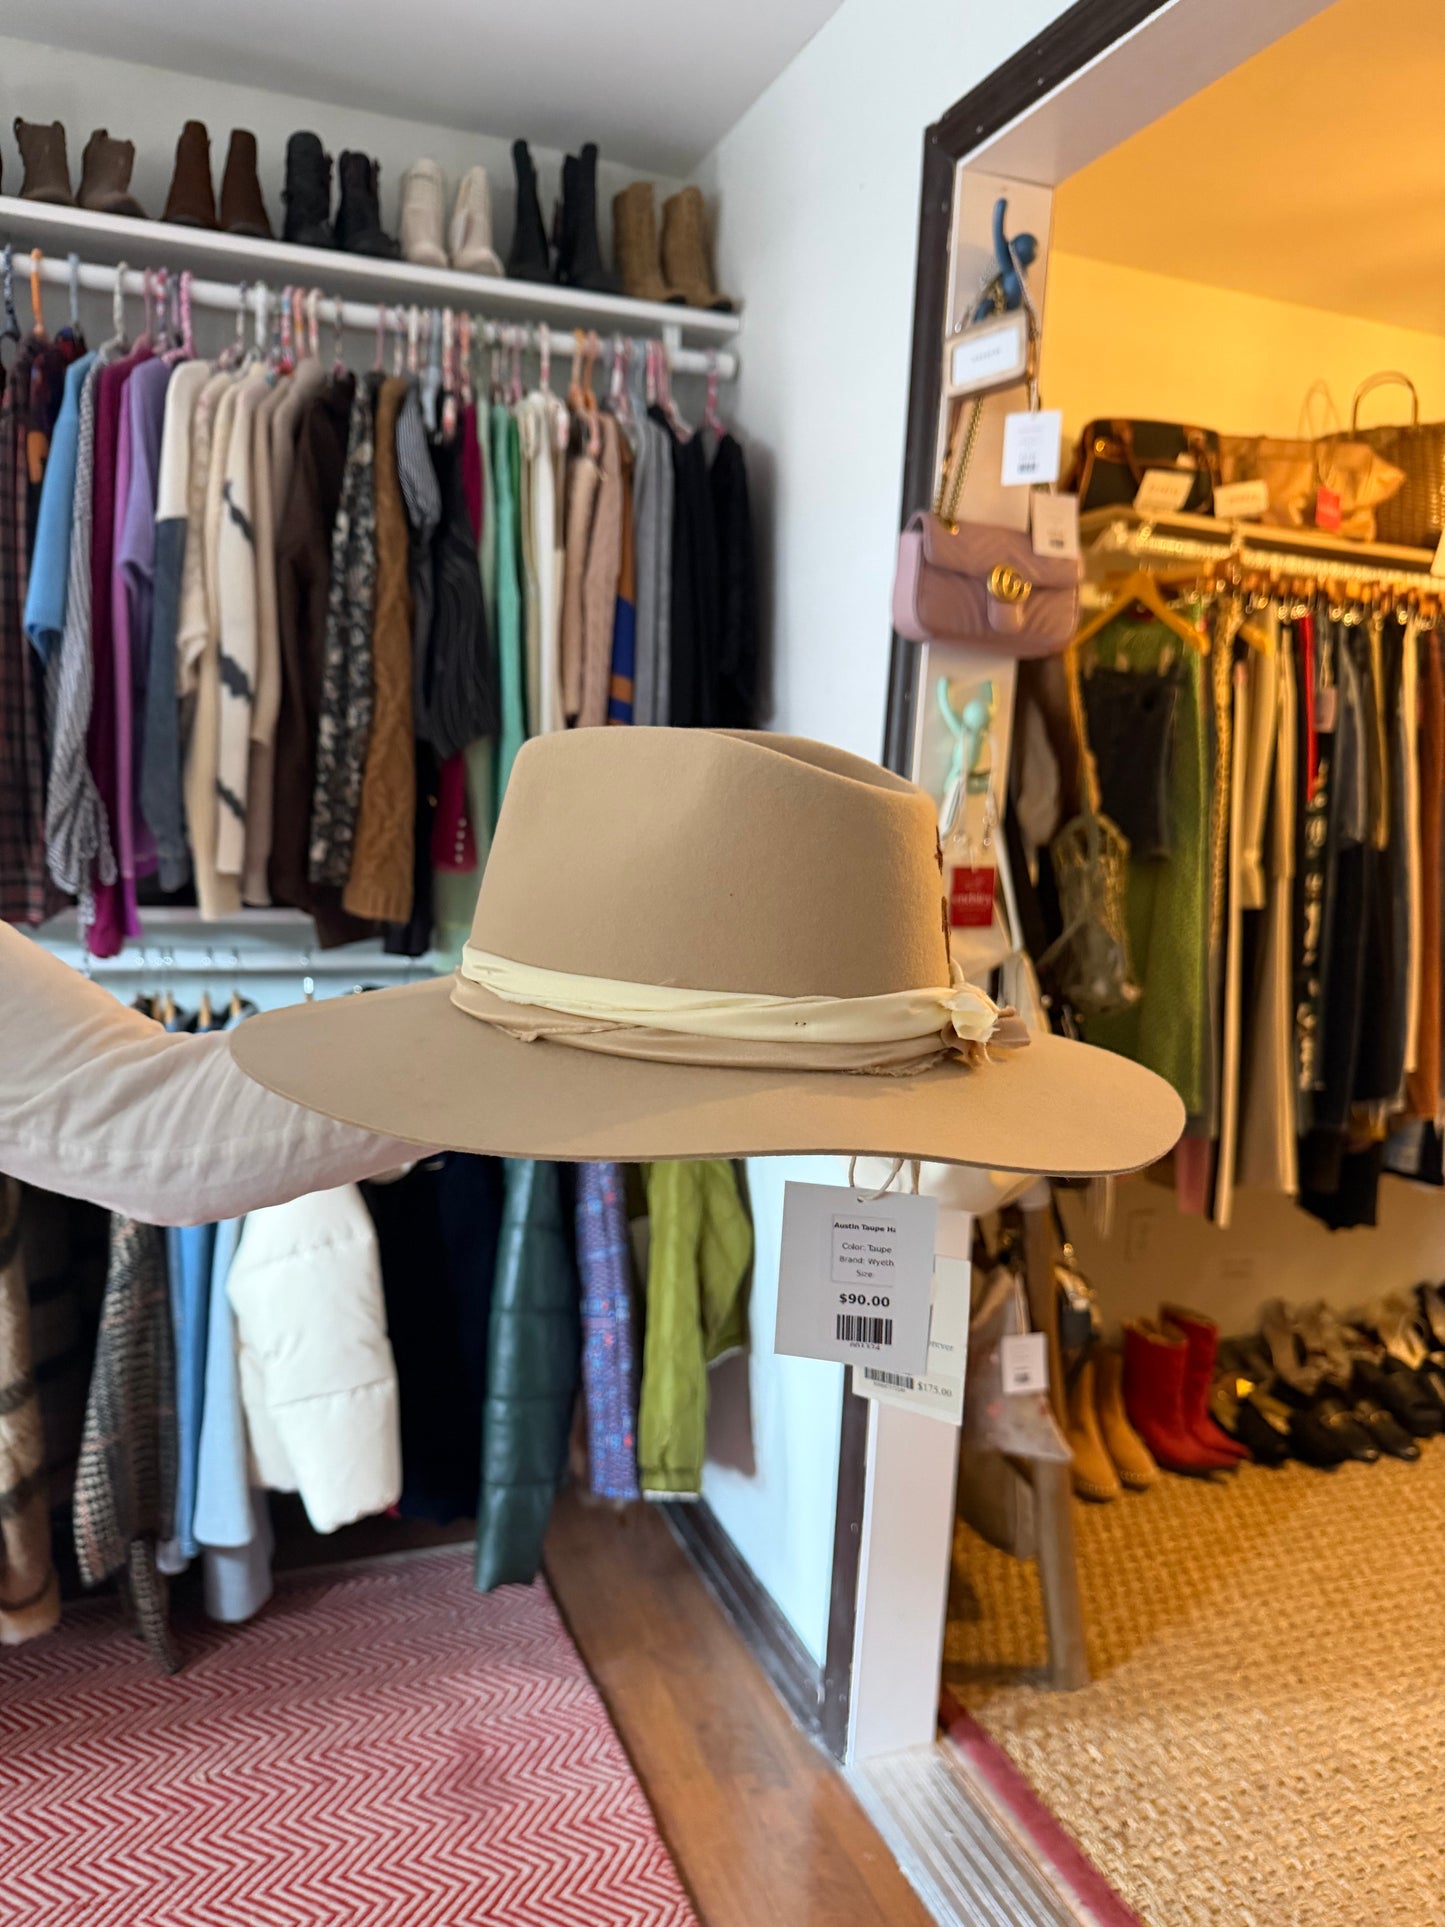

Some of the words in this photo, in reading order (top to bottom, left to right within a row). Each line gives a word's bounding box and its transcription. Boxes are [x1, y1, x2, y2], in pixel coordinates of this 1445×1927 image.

[834, 1221, 860, 1230] Austin
[861, 1223, 885, 1233] Taupe
[841, 1242, 865, 1251] Color:
[867, 1244, 893, 1254] Taupe
[839, 1255, 865, 1264] Brand:
[868, 1257, 895, 1267] Wyeth
[839, 1293, 890, 1307] $90.00
[917, 1380, 953, 1397] $175.00
